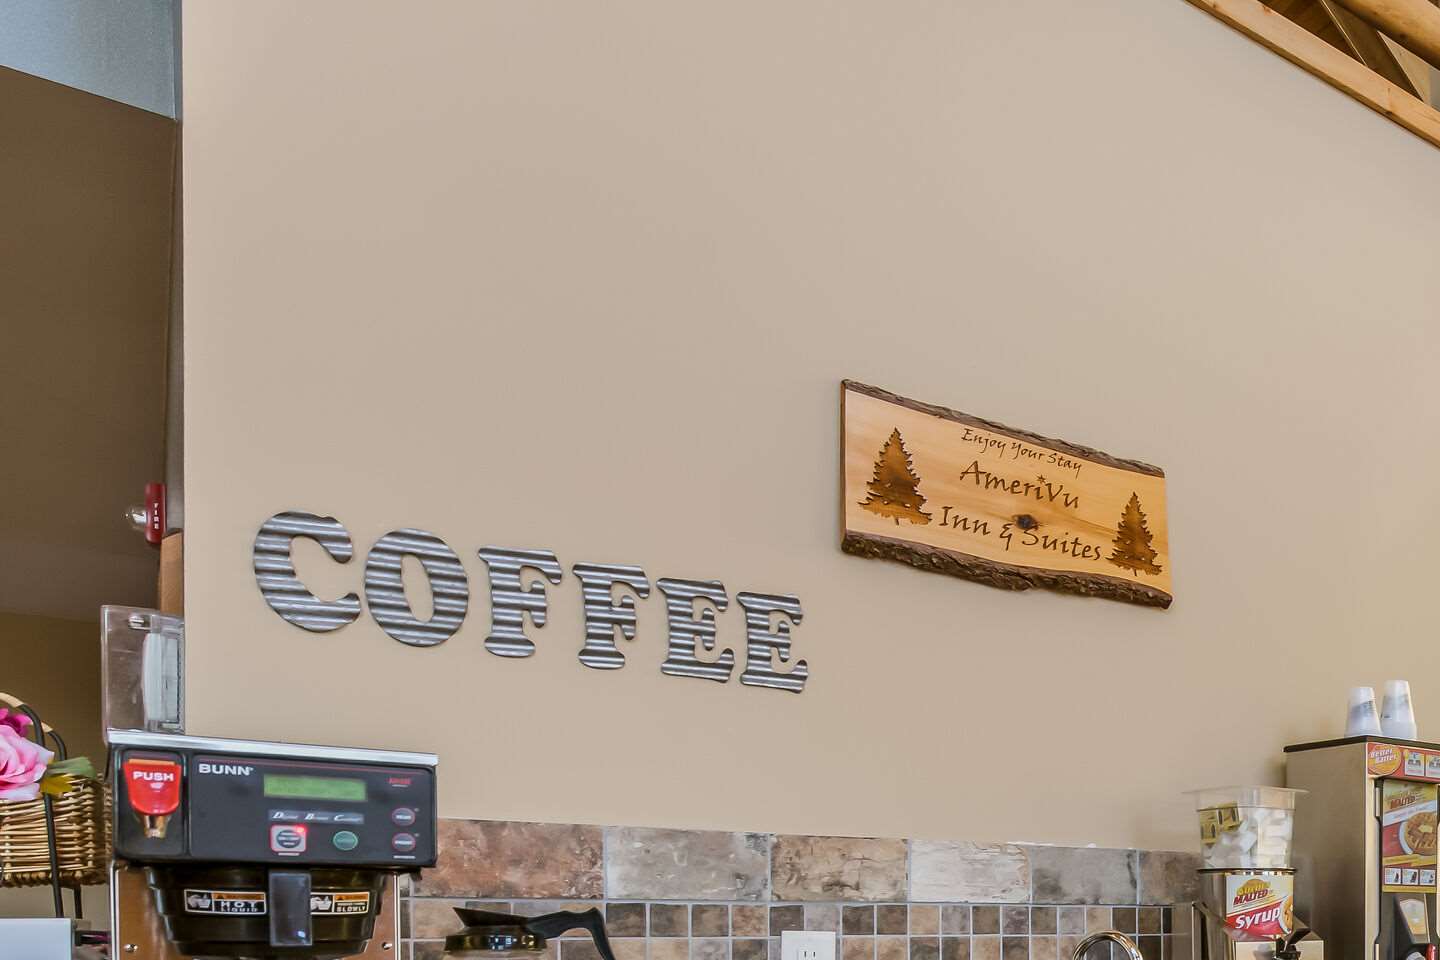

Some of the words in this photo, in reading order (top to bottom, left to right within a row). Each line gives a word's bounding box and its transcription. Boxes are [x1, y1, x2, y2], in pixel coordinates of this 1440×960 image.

[961, 427, 1007, 459] Enjoy
[1011, 441, 1044, 460] Your
[1046, 452, 1083, 479] Stay
[959, 460, 1080, 509] AmeriVu
[938, 505, 991, 537] Inn
[1021, 525, 1102, 561] Suites
[253, 510, 809, 694] COFFEE
[132, 770, 175, 782] PUSH
[198, 763, 252, 776] BUNN
[220, 900, 258, 908] HOT
[1235, 906, 1281, 929] Syrup
